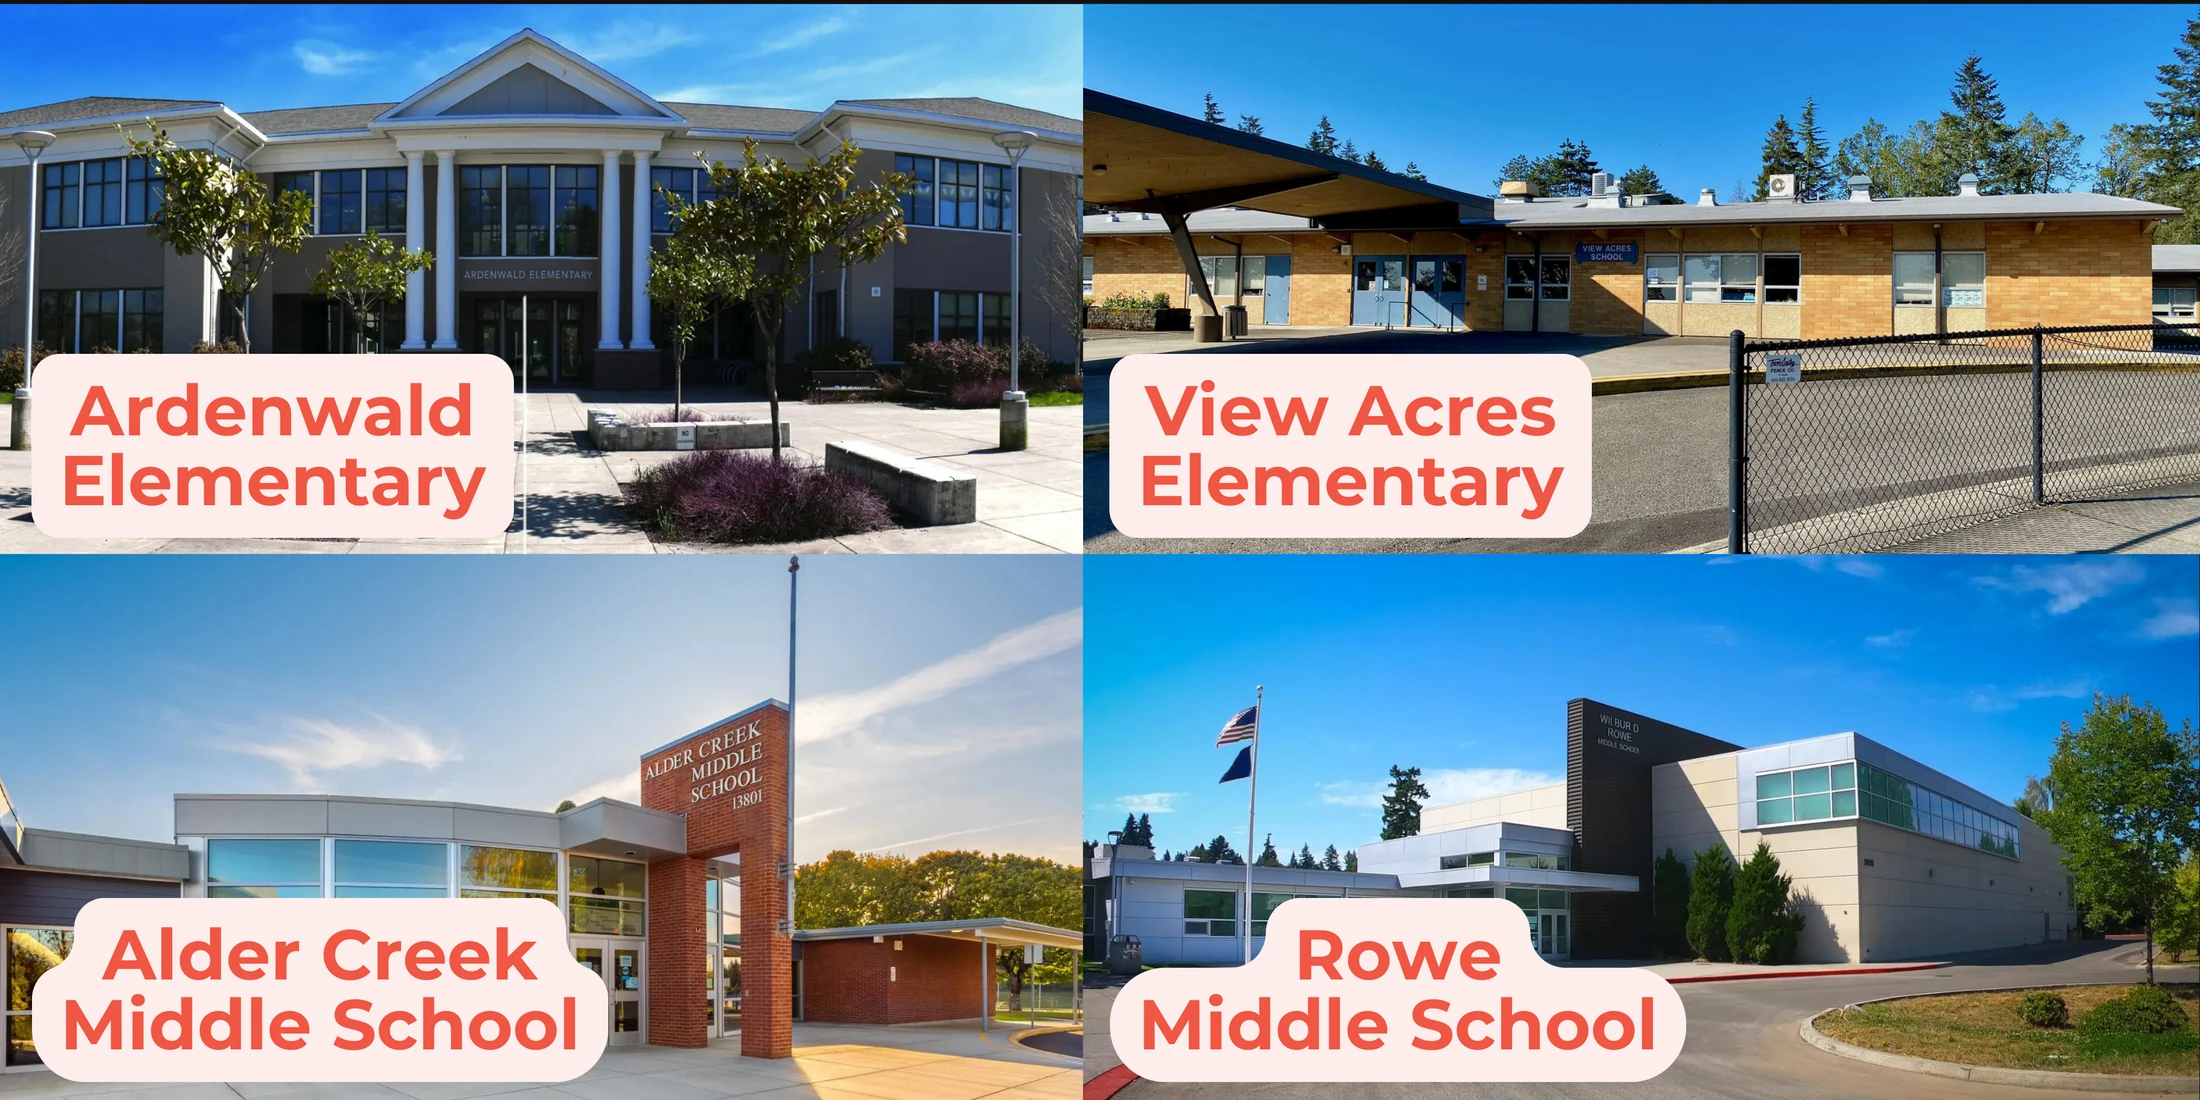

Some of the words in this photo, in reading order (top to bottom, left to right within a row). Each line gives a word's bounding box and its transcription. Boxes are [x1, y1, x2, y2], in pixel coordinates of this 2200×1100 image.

[1605, 244, 1632, 252] ACRES
[1590, 253, 1624, 261] SCHOOL
[463, 270, 526, 280] ARDENWALD
[529, 270, 593, 280] ELEMENTARY
[1600, 714, 1631, 731] WILBUR
[1633, 724, 1639, 732] D
[1607, 728, 1632, 742] ROWE
[644, 749, 694, 780] ALDER
[698, 720, 762, 758] CREEK
[1598, 738, 1618, 748] MIDDLE
[1619, 743, 1640, 754] SCHOOL
[691, 742, 763, 783] MIDDLE
[691, 767, 763, 803] SCHOOL
[732, 789, 763, 810] 13801
